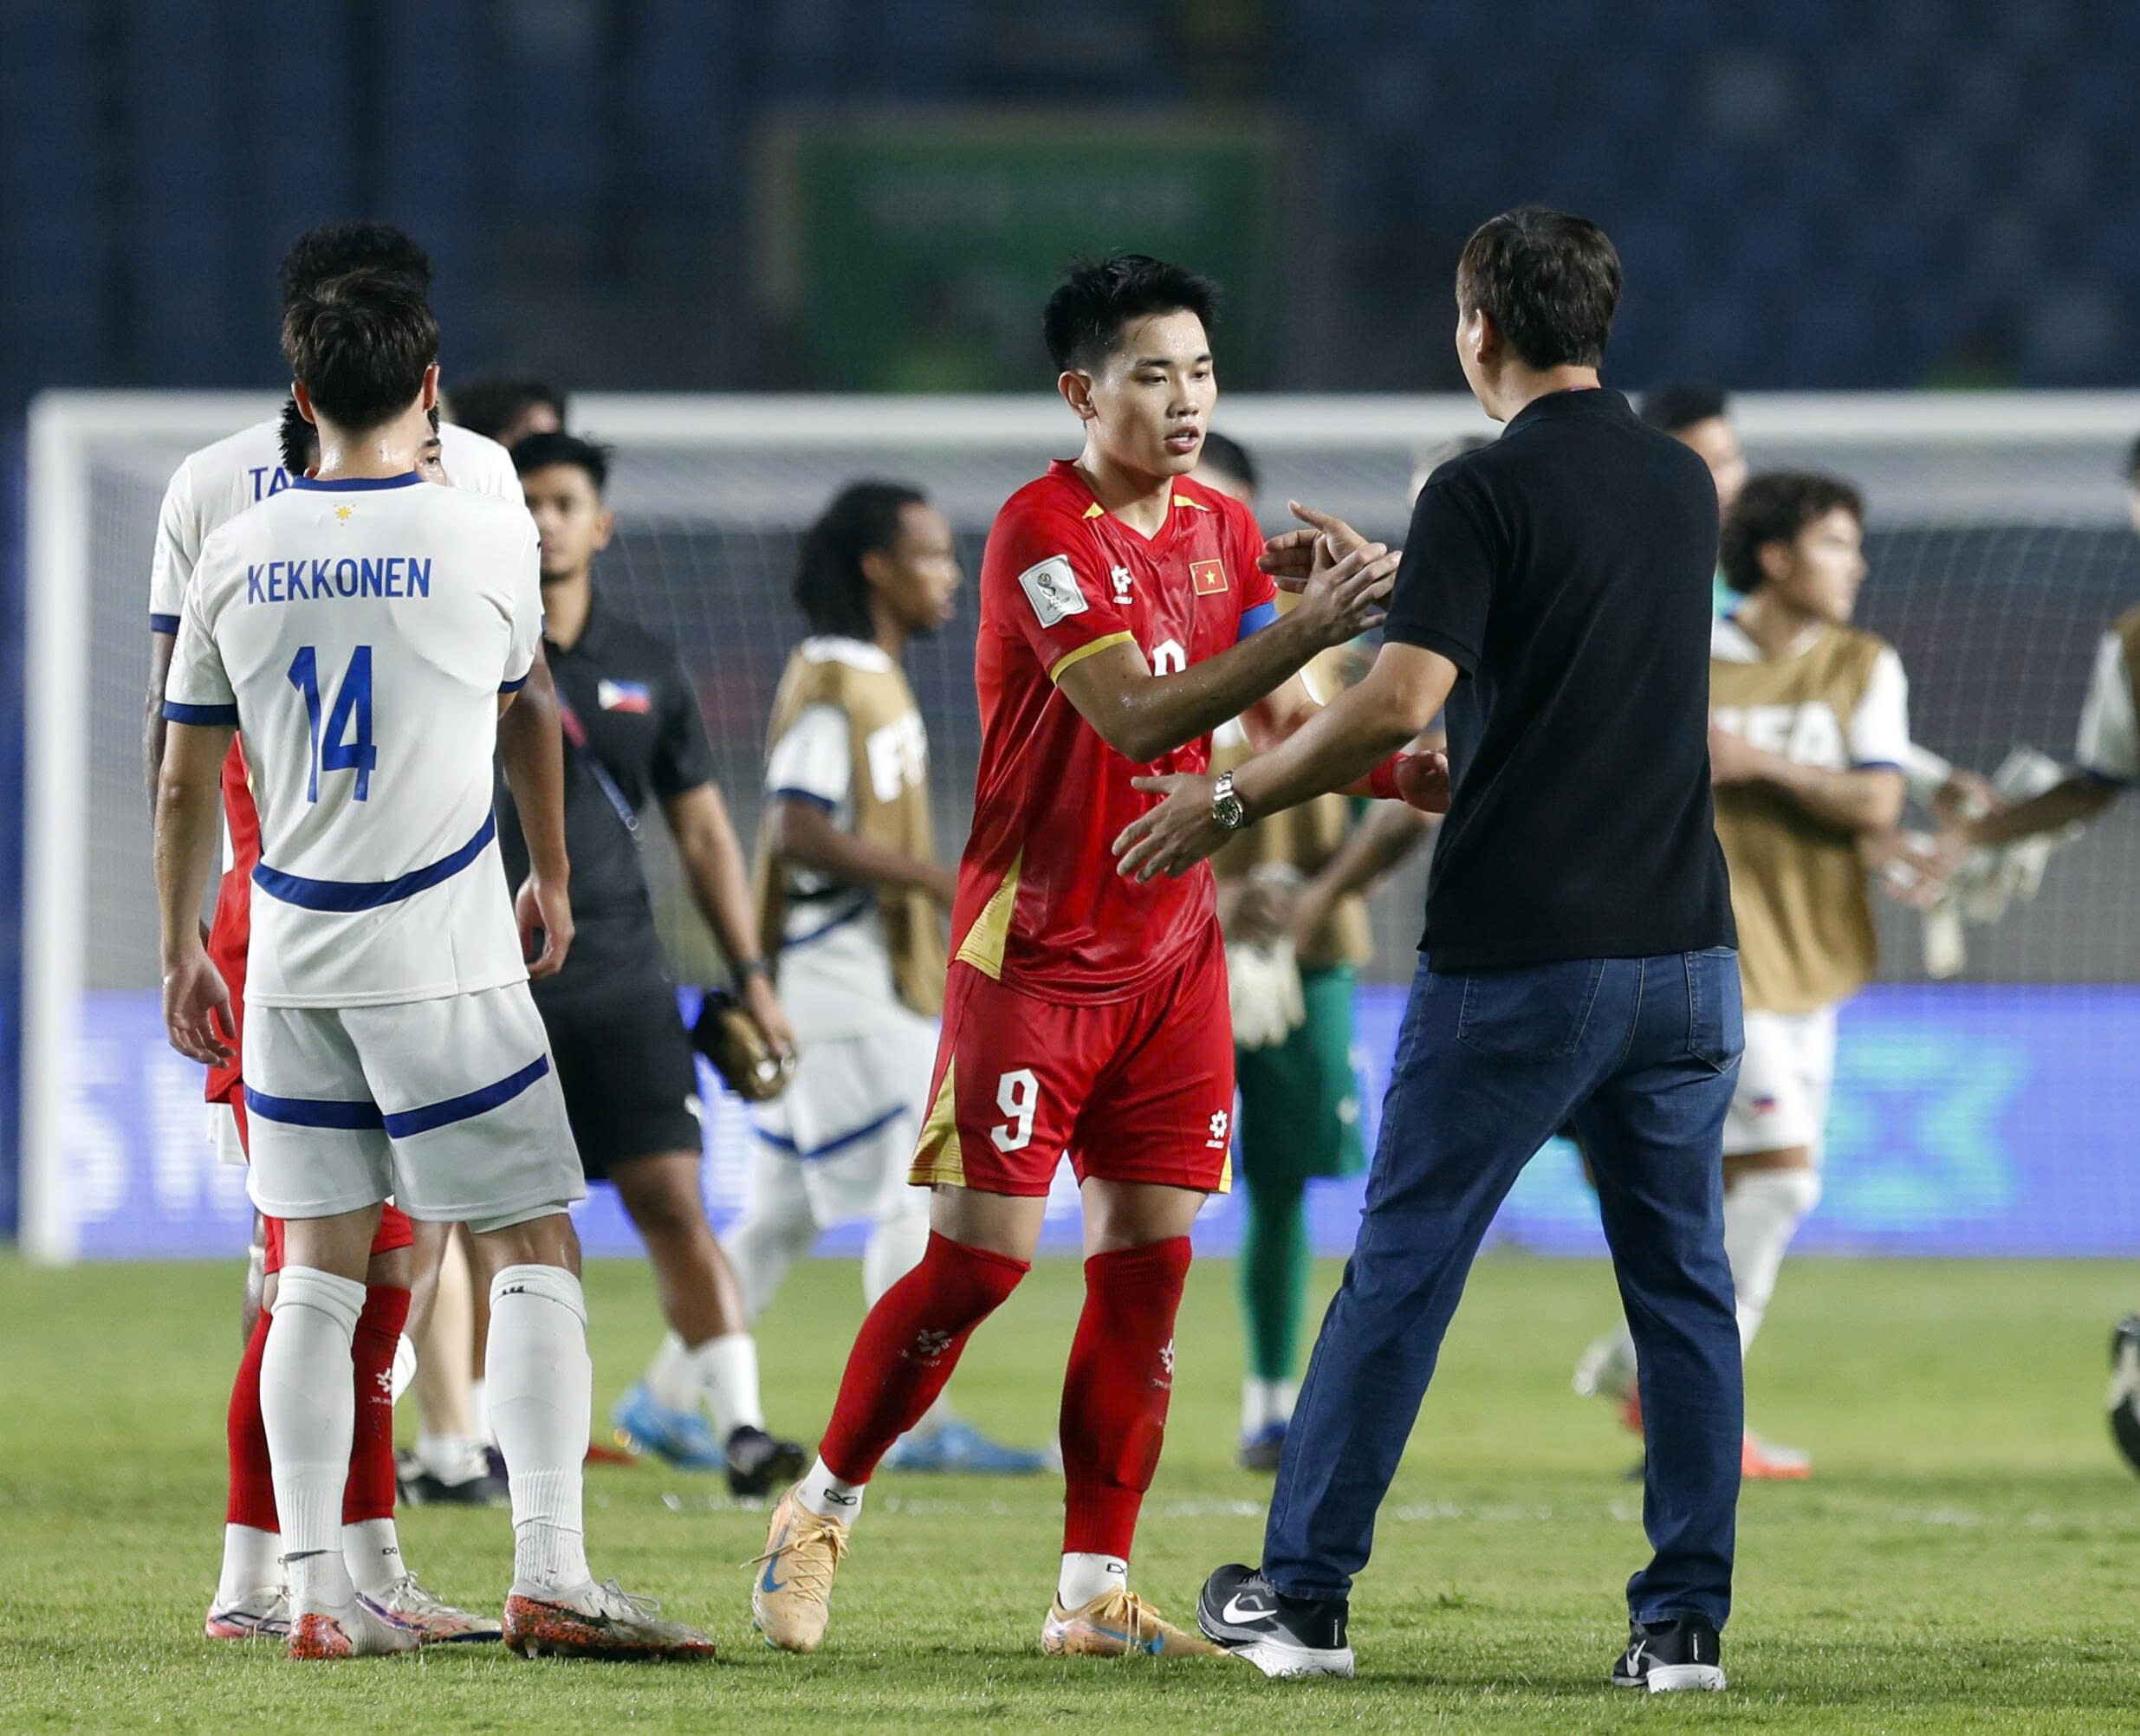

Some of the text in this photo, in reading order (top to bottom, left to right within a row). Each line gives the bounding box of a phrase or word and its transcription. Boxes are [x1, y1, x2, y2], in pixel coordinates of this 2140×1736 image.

[248, 558, 431, 605] KEKKONEN
[287, 645, 377, 803] 14
[991, 1068, 1039, 1153] 9
